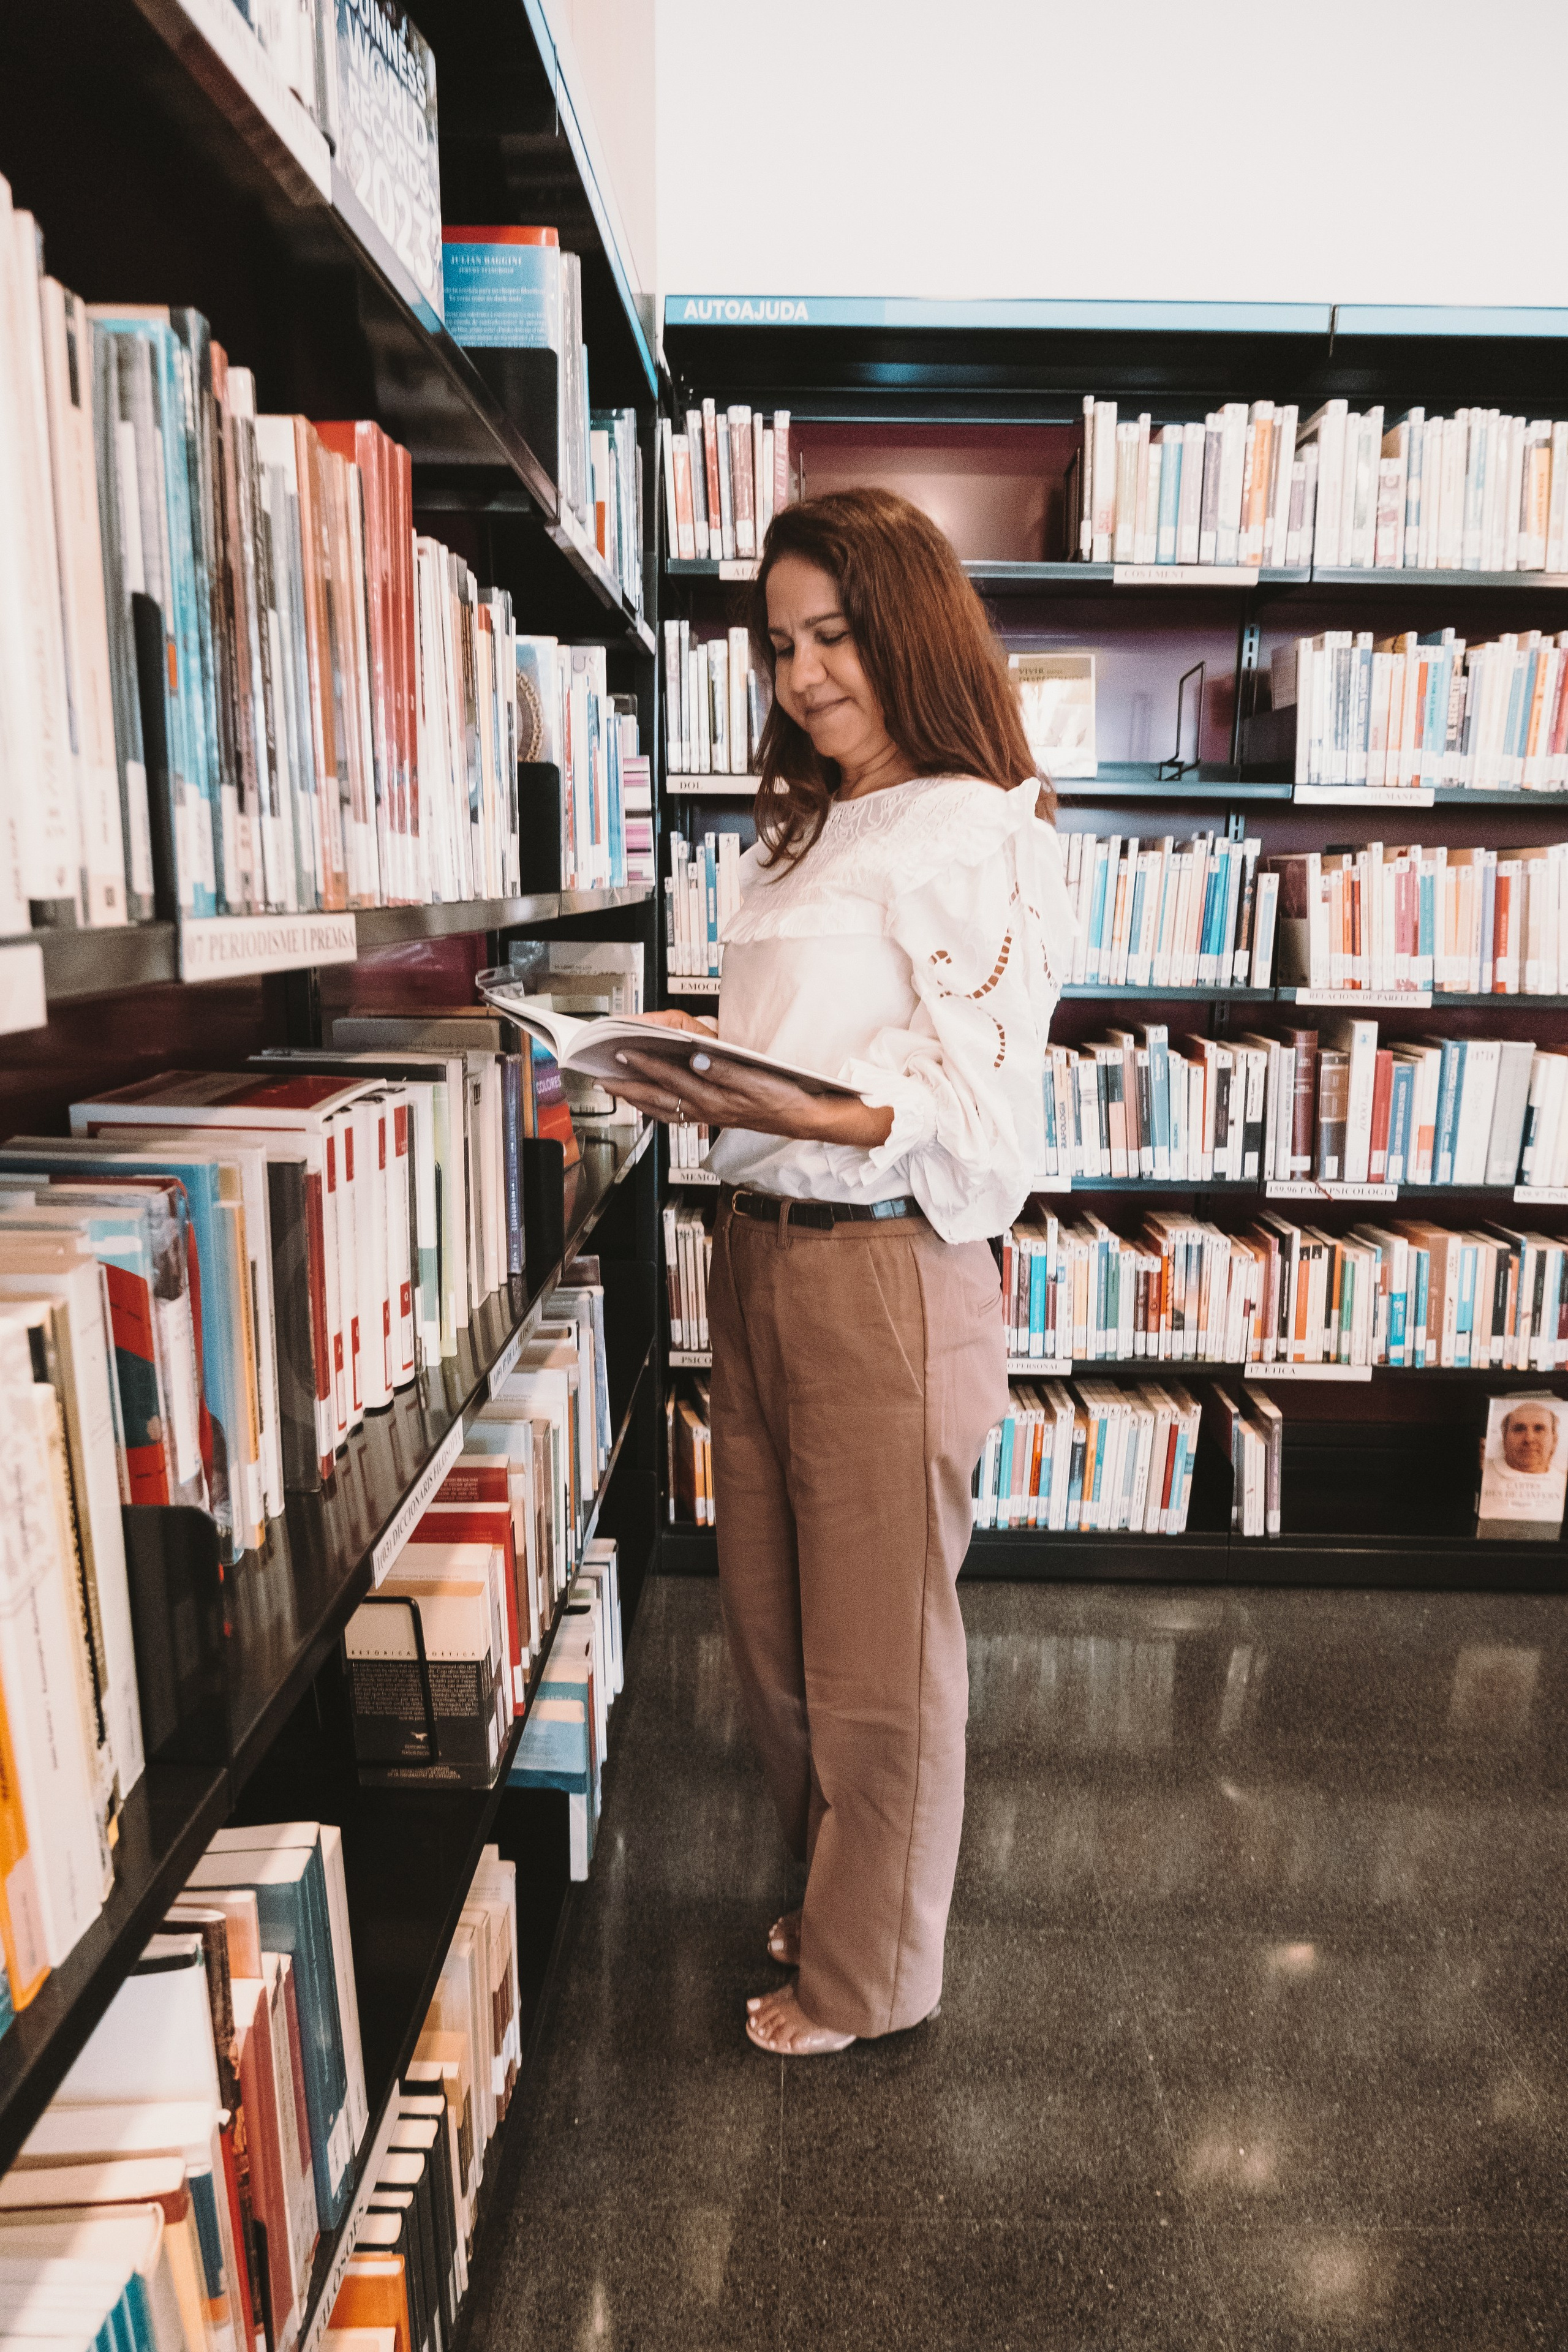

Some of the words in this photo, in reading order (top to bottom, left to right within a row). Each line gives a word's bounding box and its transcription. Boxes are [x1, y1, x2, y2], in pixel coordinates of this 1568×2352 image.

[348, 0, 427, 109] UINNESS
[347, 5, 429, 160] WORLD
[348, 66, 431, 213] RECORDS
[354, 127, 434, 291] 2023
[451, 255, 481, 265] JULIAN
[484, 255, 521, 266] BAGGINI
[683, 299, 809, 321] AUTOAJUDA
[1447, 676, 1461, 725] SECRETO
[679, 780, 703, 790] DOL
[208, 928, 298, 962] PERIODISME
[310, 925, 356, 951] PREMSA
[1309, 992, 1360, 1001] RELACIONS
[1362, 993, 1374, 1001] DE
[1376, 993, 1418, 1003] PARELLA
[1268, 1185, 1298, 1194] 159.96
[393, 1476, 433, 1547] DICCIONARIS
